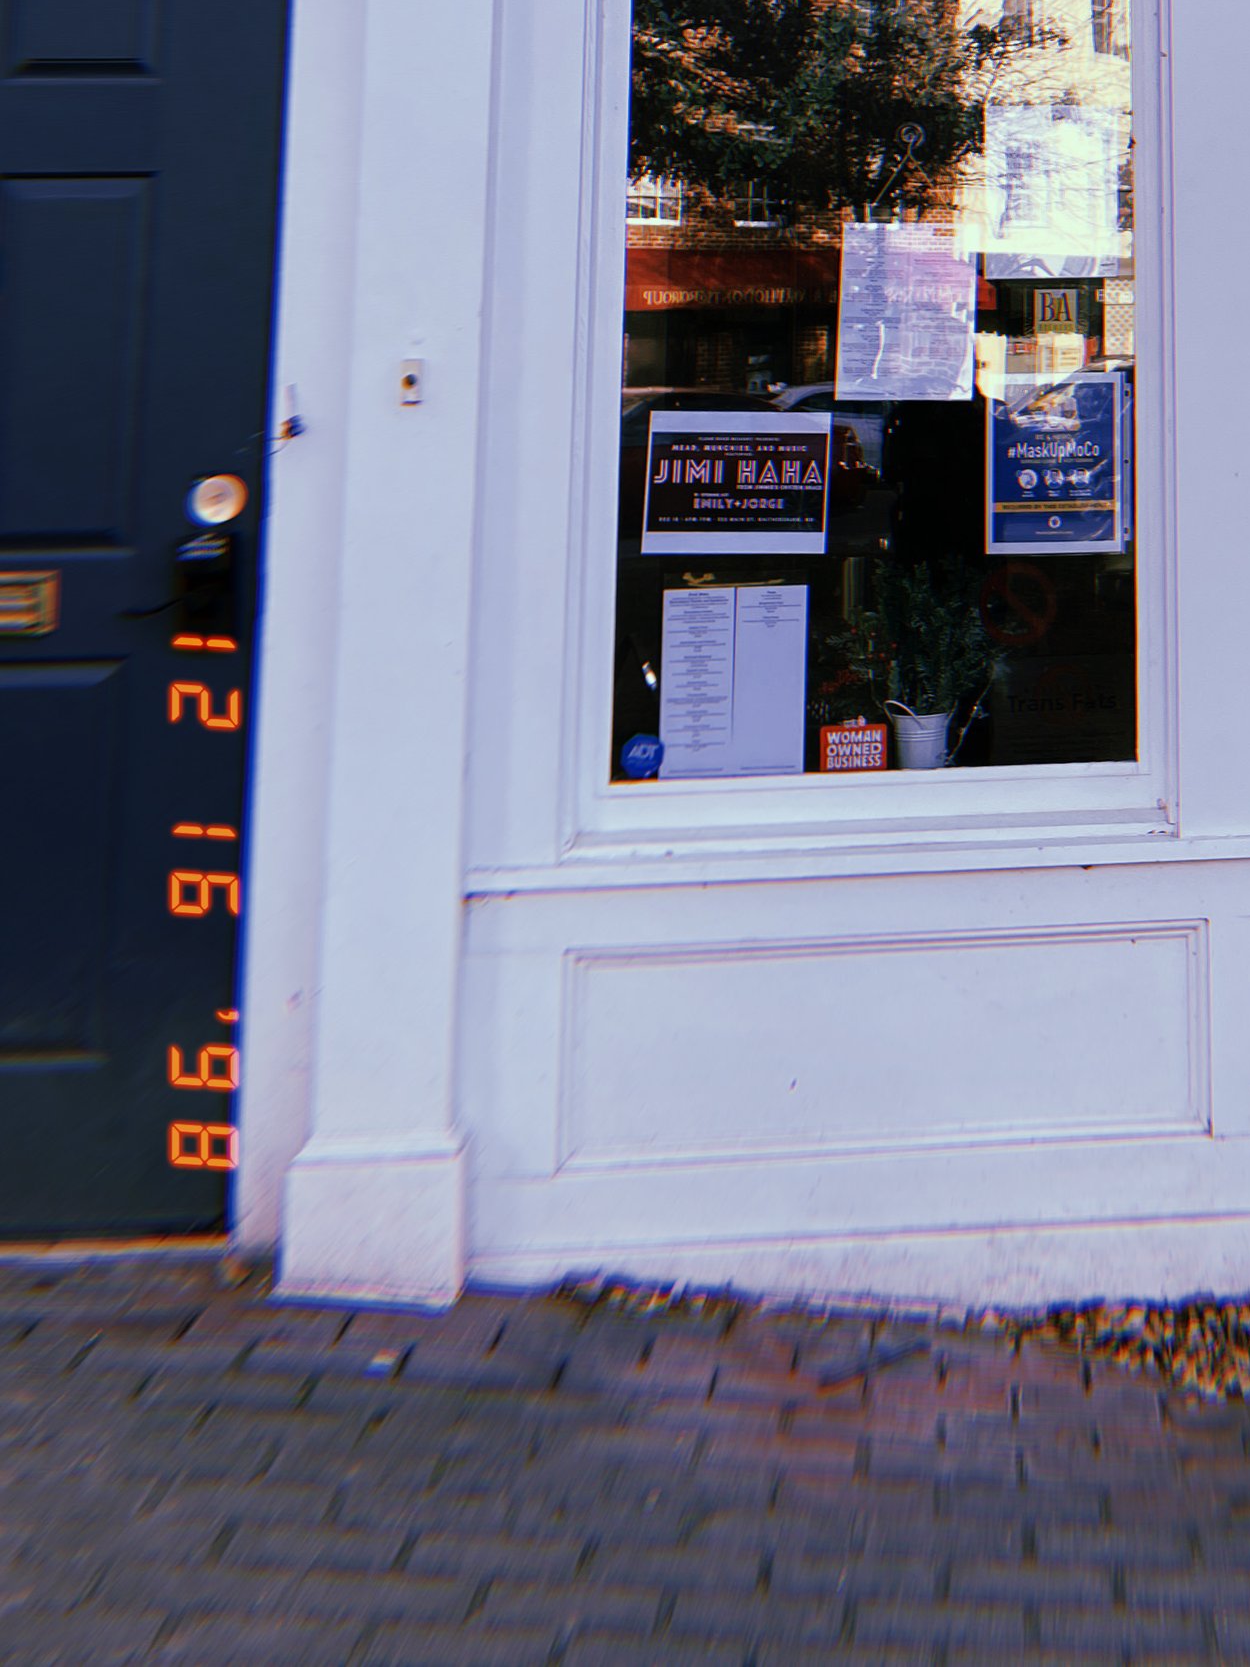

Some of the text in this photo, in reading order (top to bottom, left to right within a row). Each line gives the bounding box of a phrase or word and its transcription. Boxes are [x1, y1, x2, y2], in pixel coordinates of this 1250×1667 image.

[653, 459, 823, 484] JIMI HAHA
[826, 730, 883, 745] WOMAN
[627, 743, 660, 760] ADT
[826, 742, 883, 756] OWNED
[826, 754, 883, 769] BUSINESS
